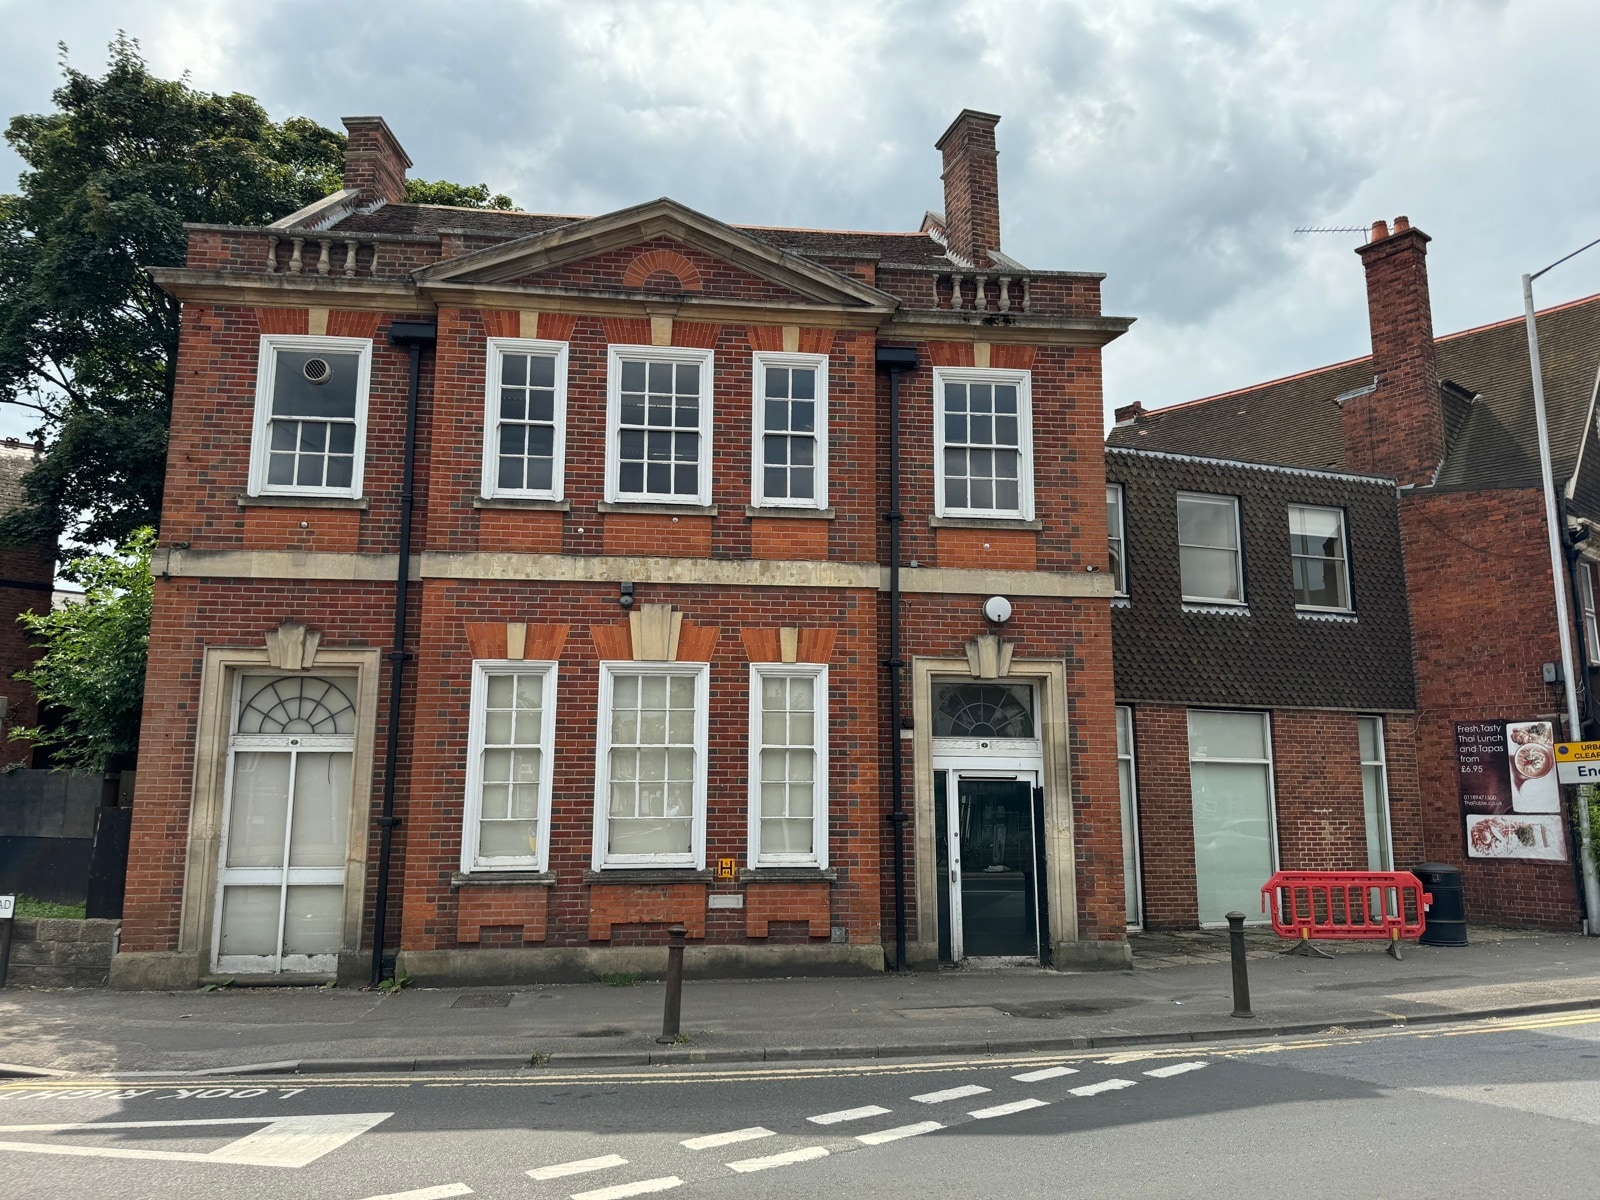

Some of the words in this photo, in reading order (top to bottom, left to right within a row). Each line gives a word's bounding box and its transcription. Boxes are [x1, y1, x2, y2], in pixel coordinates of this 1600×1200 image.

[1458, 735, 1475, 743] Thai
[1477, 734, 1504, 742] Lunch
[1460, 745, 1477, 753] and
[1478, 744, 1504, 753] Tapas
[1460, 755, 1480, 763] from
[1461, 765, 1483, 773] £6.95
[720, 860, 733, 877] H
[154, 1088, 306, 1100] LOOK
